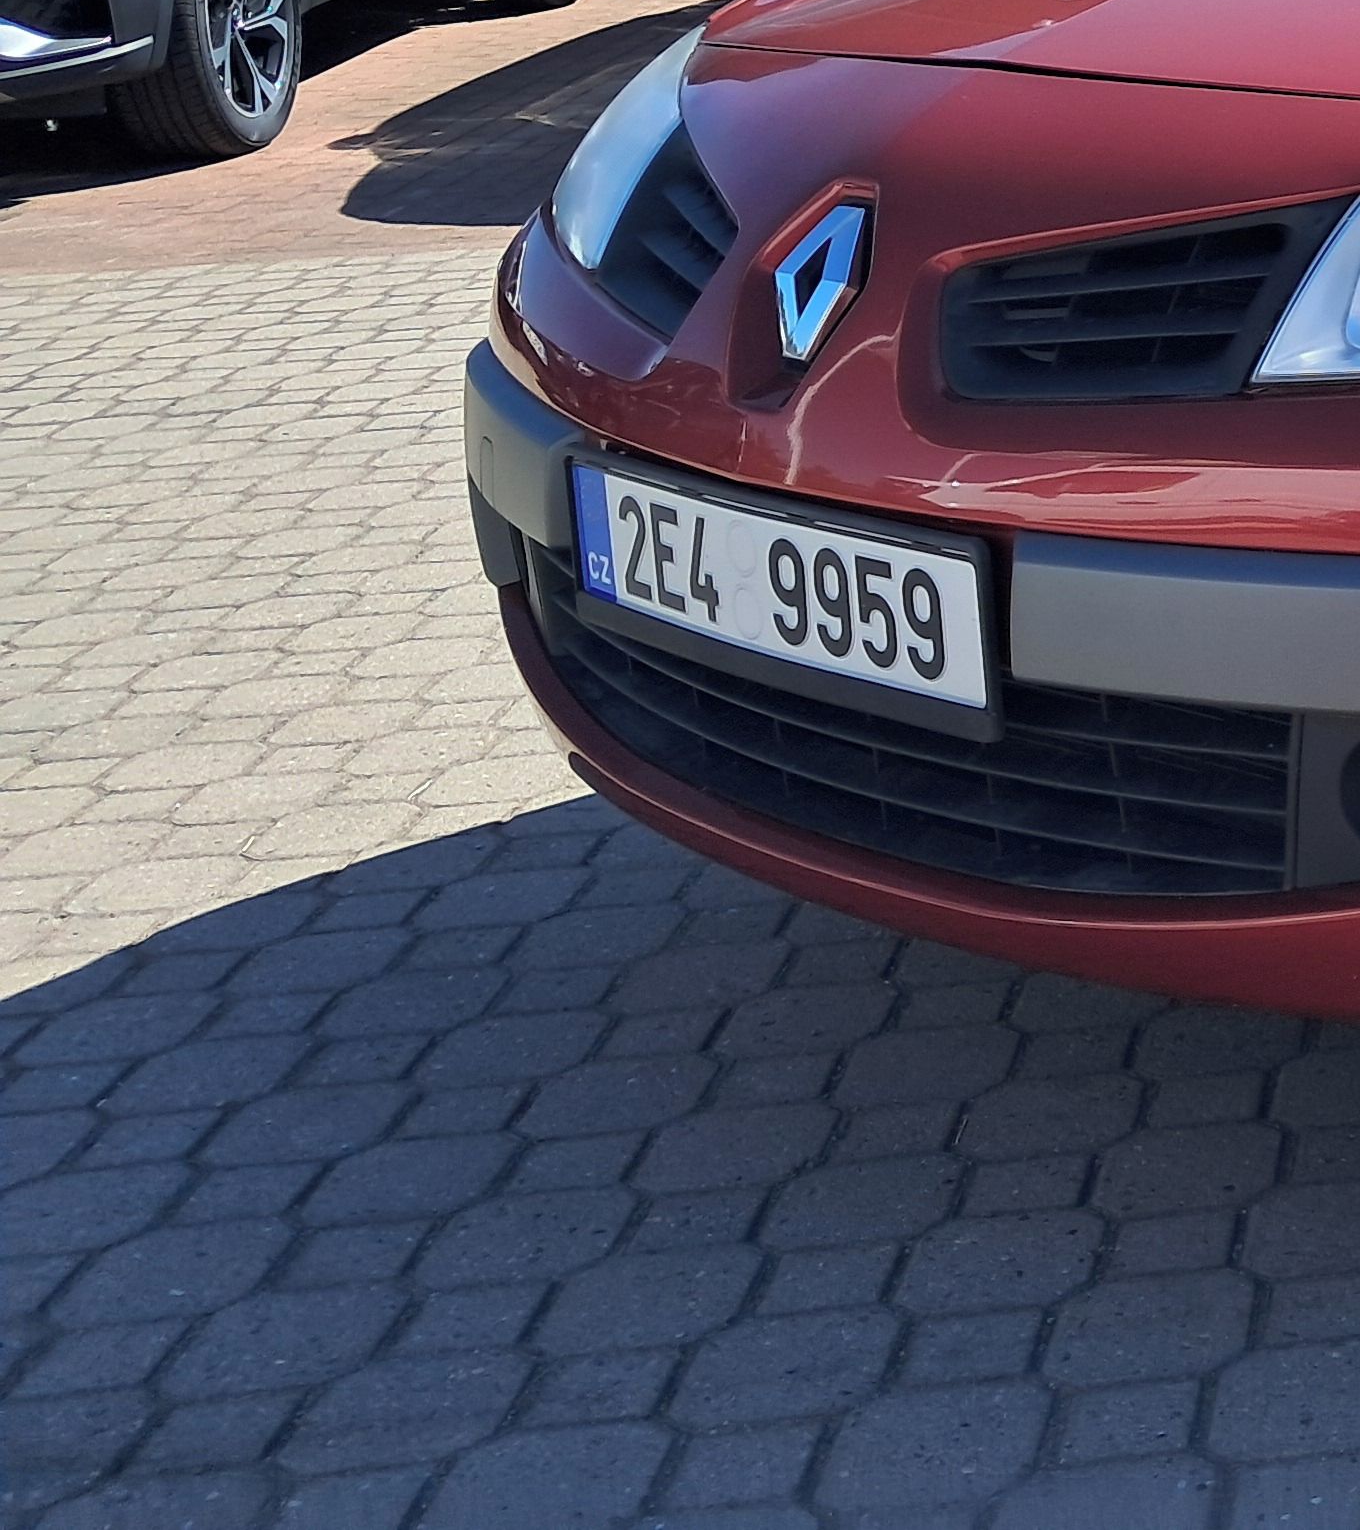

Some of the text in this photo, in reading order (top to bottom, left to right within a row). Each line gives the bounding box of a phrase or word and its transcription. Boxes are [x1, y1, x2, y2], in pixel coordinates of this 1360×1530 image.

[587, 550, 612, 585] CZ
[617, 494, 947, 681] 2E4 9959
